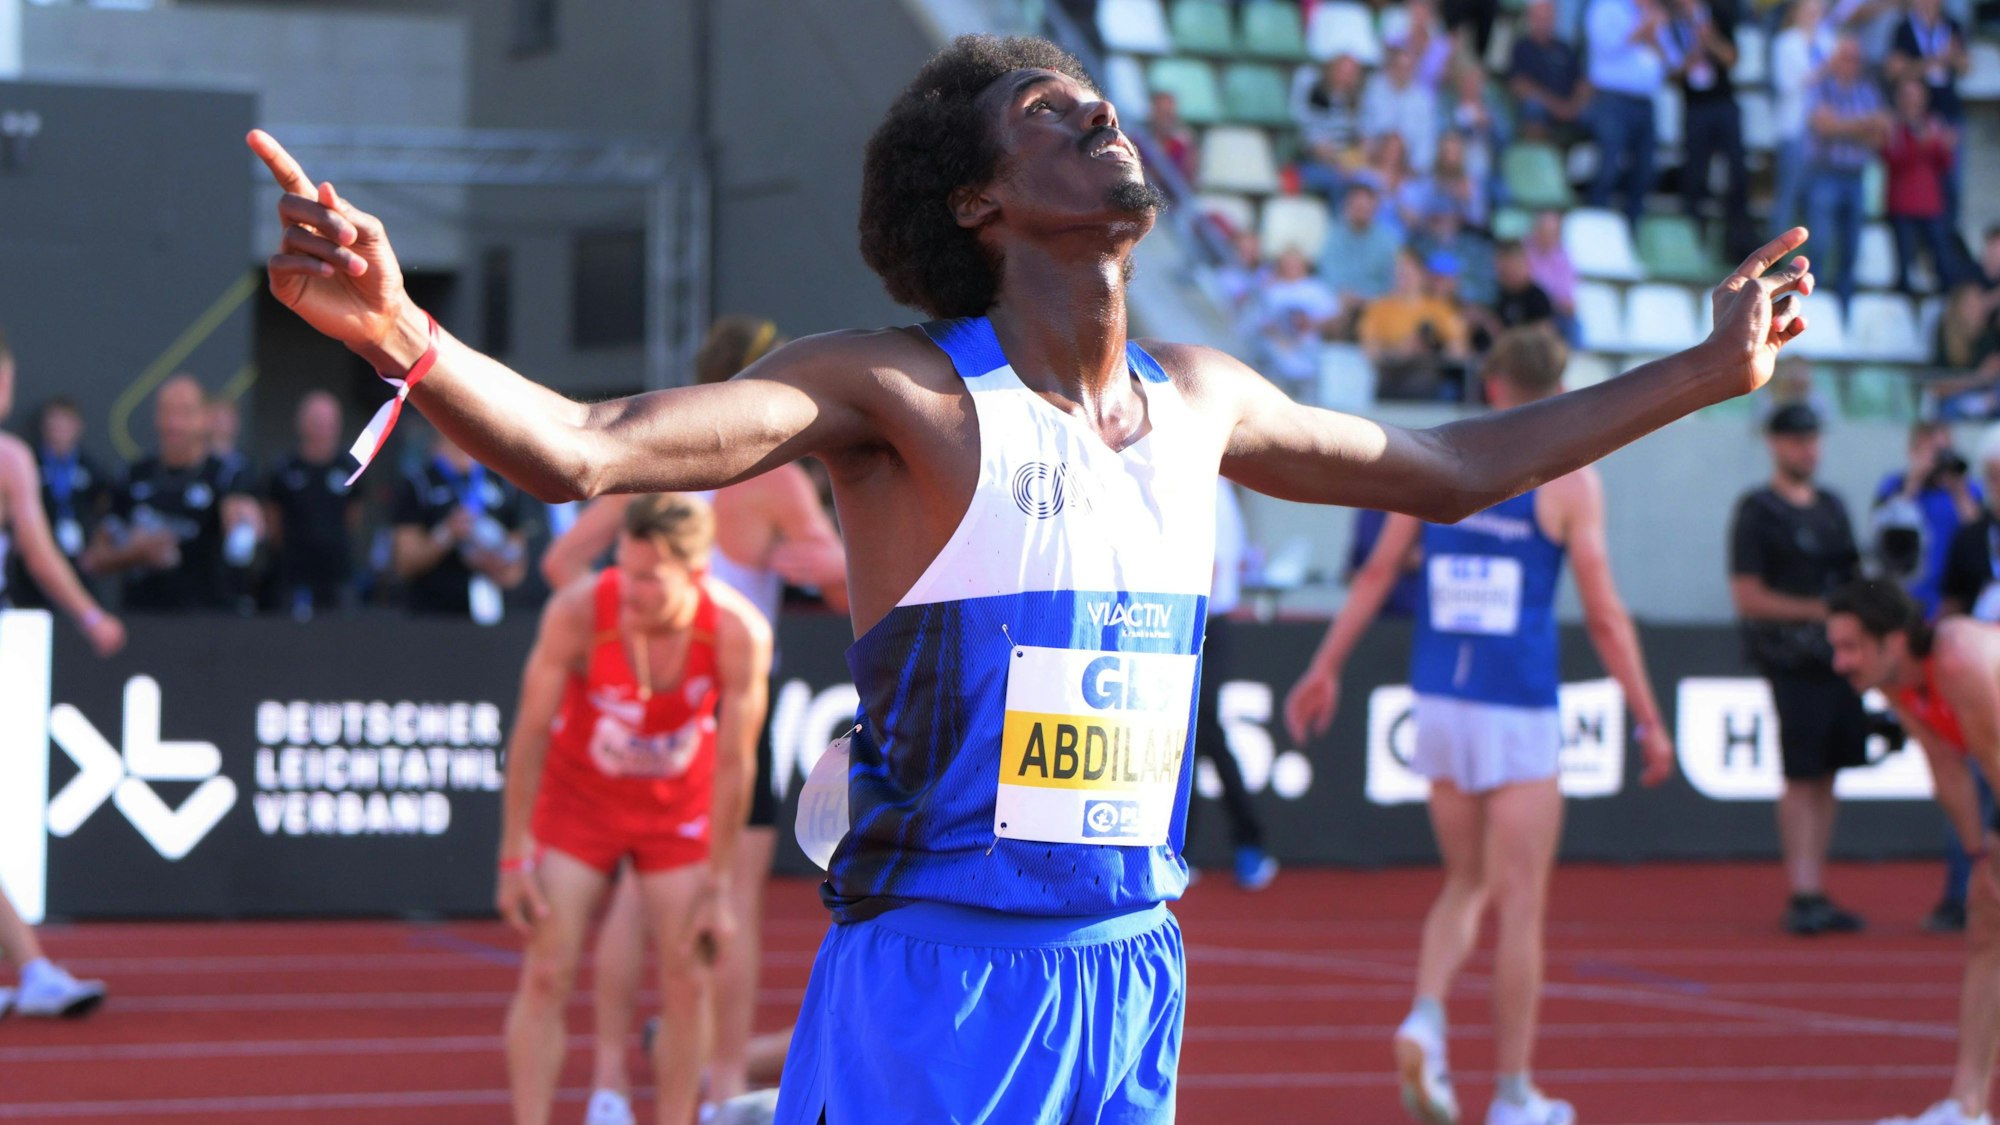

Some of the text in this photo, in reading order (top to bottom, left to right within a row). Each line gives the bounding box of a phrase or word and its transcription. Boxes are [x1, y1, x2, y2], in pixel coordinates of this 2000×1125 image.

[1086, 601, 1173, 628] VIACTIV
[255, 700, 502, 746] DEUTSCHER
[255, 746, 506, 792] LEICHTATHL
[252, 790, 451, 836] VERBAND
